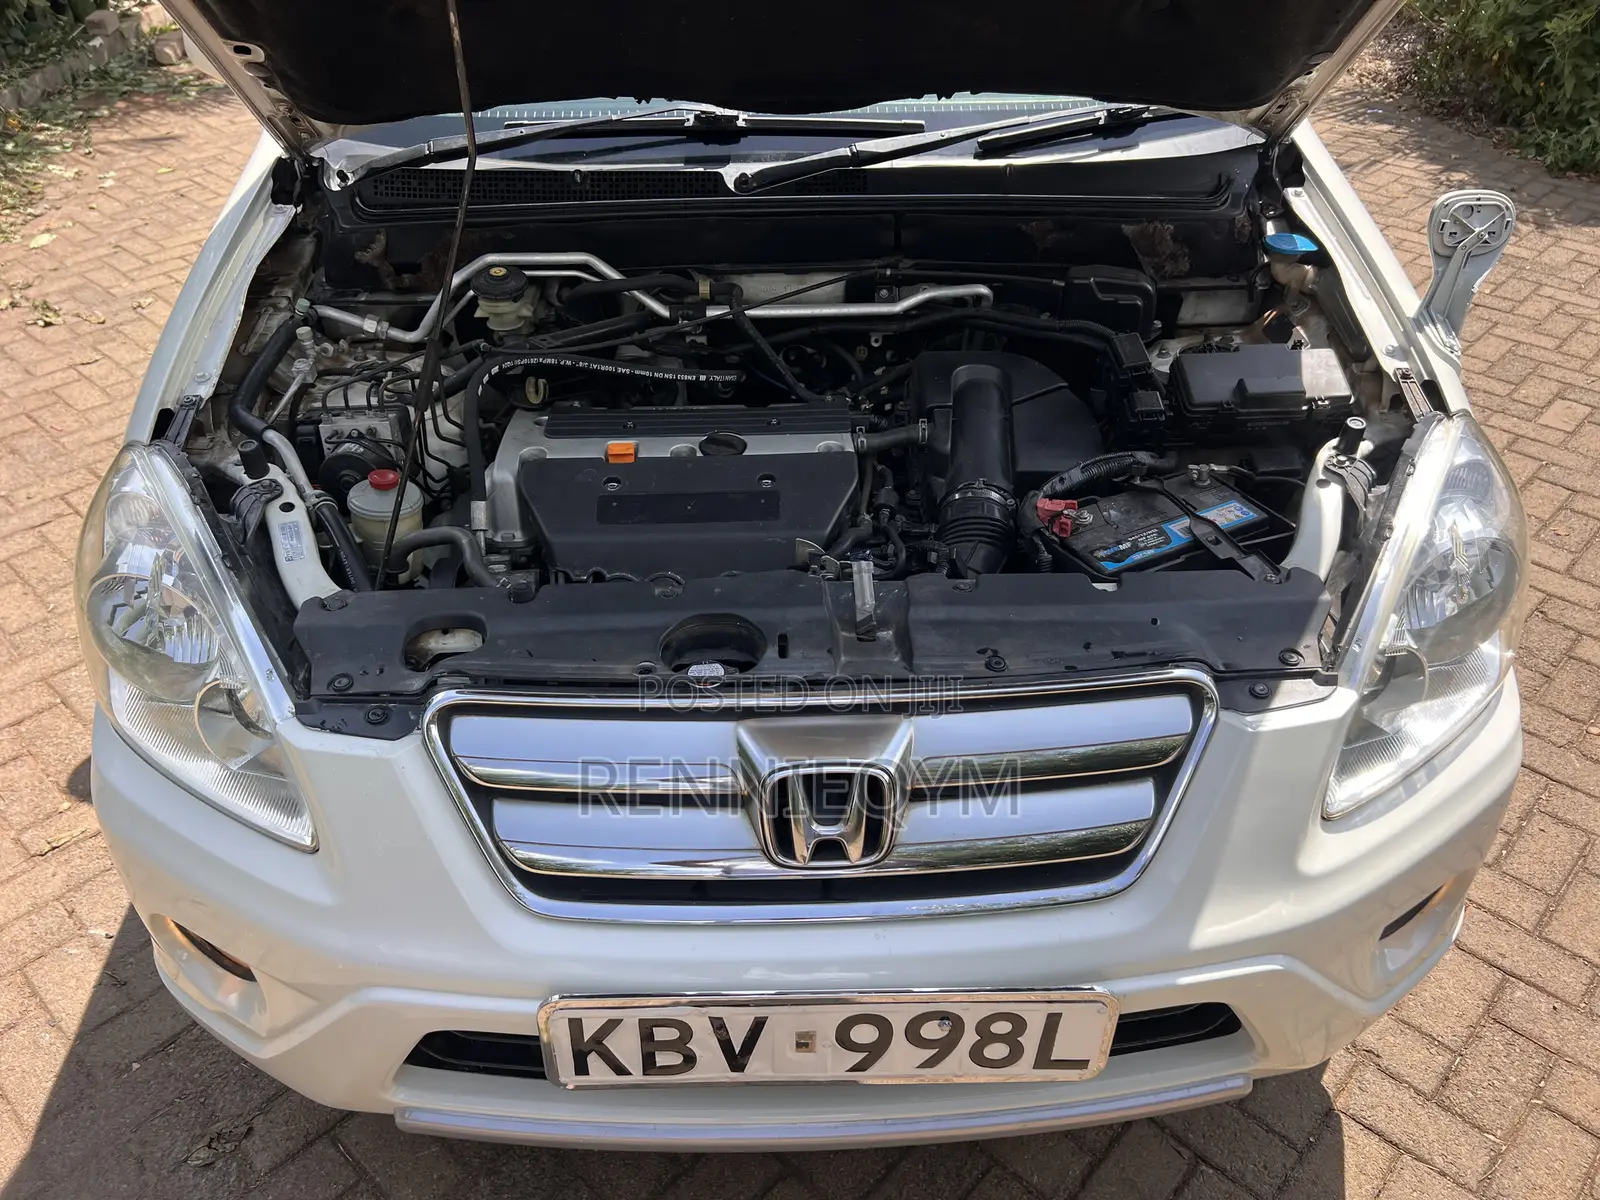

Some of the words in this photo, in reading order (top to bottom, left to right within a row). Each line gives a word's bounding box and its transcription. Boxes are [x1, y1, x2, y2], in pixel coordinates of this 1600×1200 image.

[589, 363, 616, 372] 100R1AT
[617, 367, 630, 375] SAE
[634, 369, 653, 377] 10mm
[567, 1016, 768, 1075] KBV
[834, 1010, 1091, 1071] 998L
